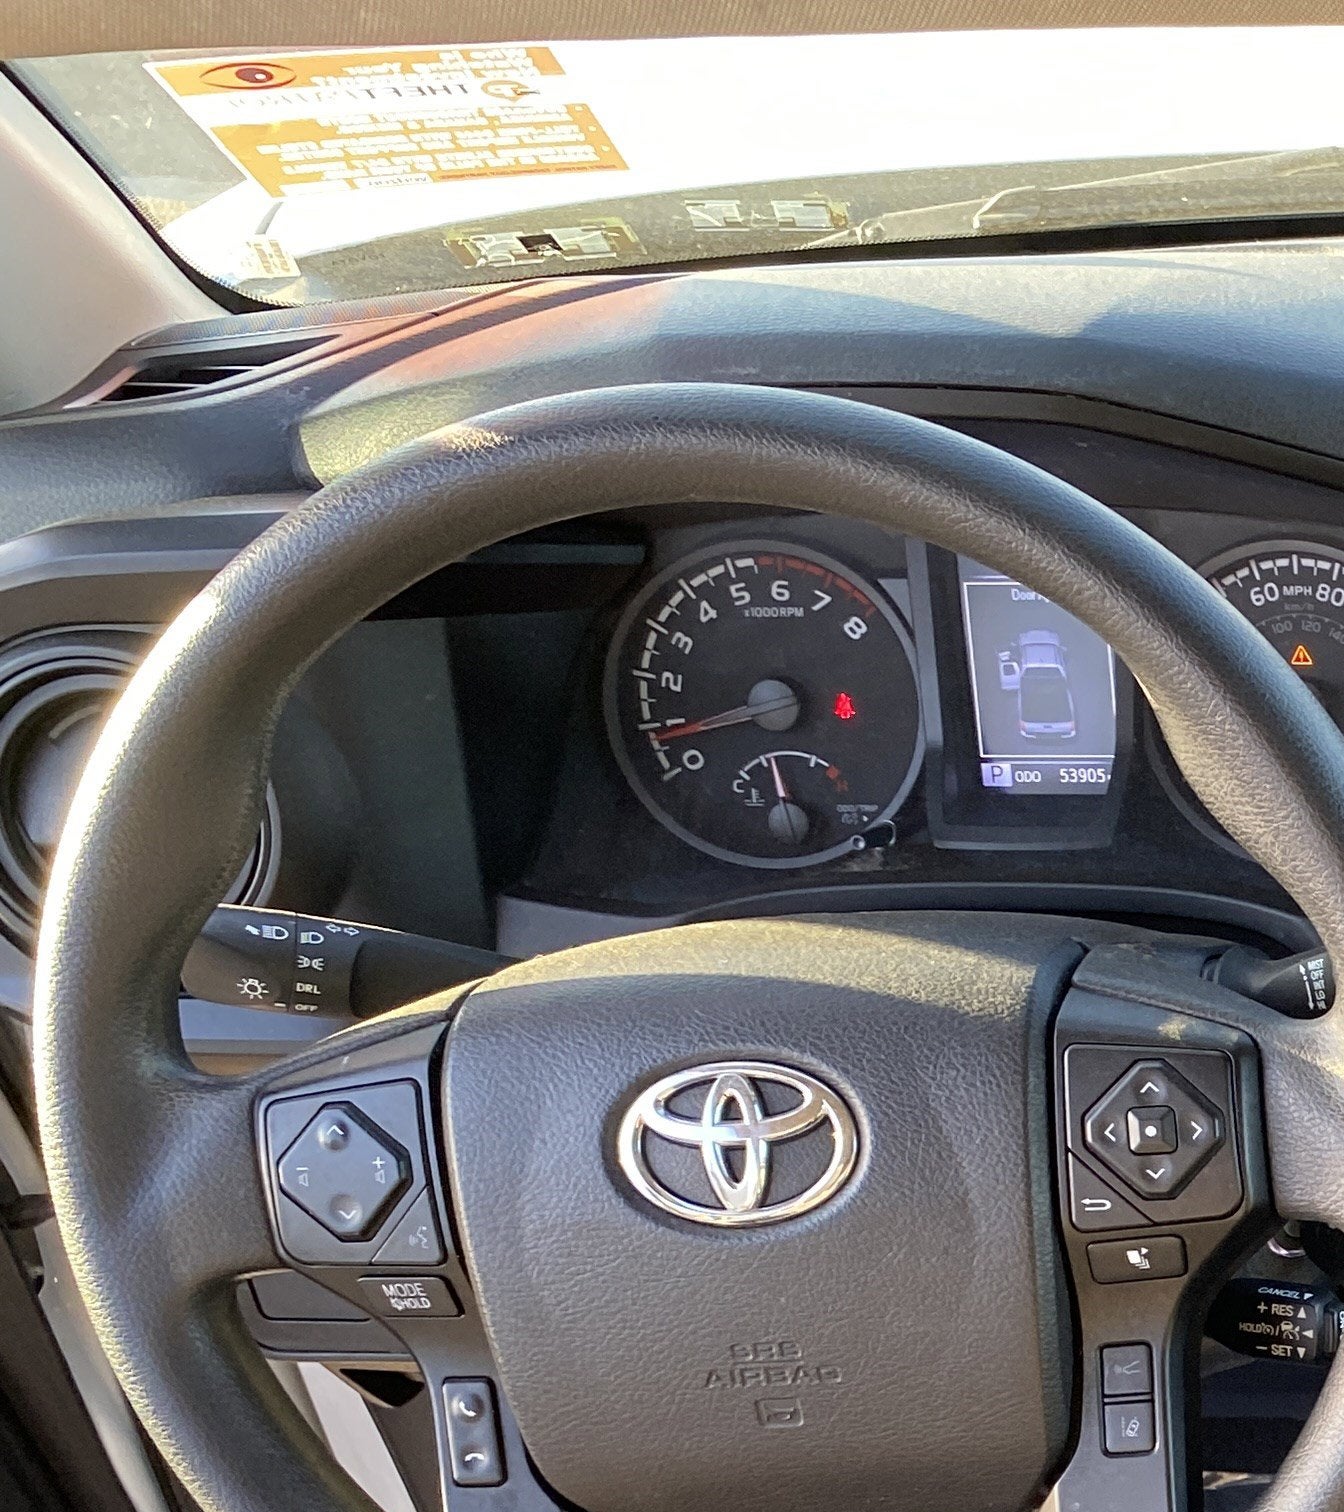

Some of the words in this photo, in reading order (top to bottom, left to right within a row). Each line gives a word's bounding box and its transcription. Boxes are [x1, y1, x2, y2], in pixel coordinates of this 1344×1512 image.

[729, 582, 750, 606] 5
[771, 580, 790, 601] 6
[811, 590, 832, 611] 7
[1250, 582, 1279, 606] 60
[1282, 585, 1312, 596] MPH
[699, 600, 717, 623] 4
[843, 616, 867, 640] 8
[1271, 620, 1293, 634] 100
[1300, 620, 1321, 633] 120
[671, 631, 693, 654] 3
[661, 671, 682, 693] 2
[682, 749, 704, 770] 0
[991, 766, 1004, 782] P
[1015, 770, 1041, 783] ODO
[1060, 768, 1106, 783] 53905
[295, 982, 321, 995] DRL
[295, 1004, 318, 1013] OFF
[381, 1283, 427, 1298] MODE
[1257, 1286, 1300, 1299] CANCEL
